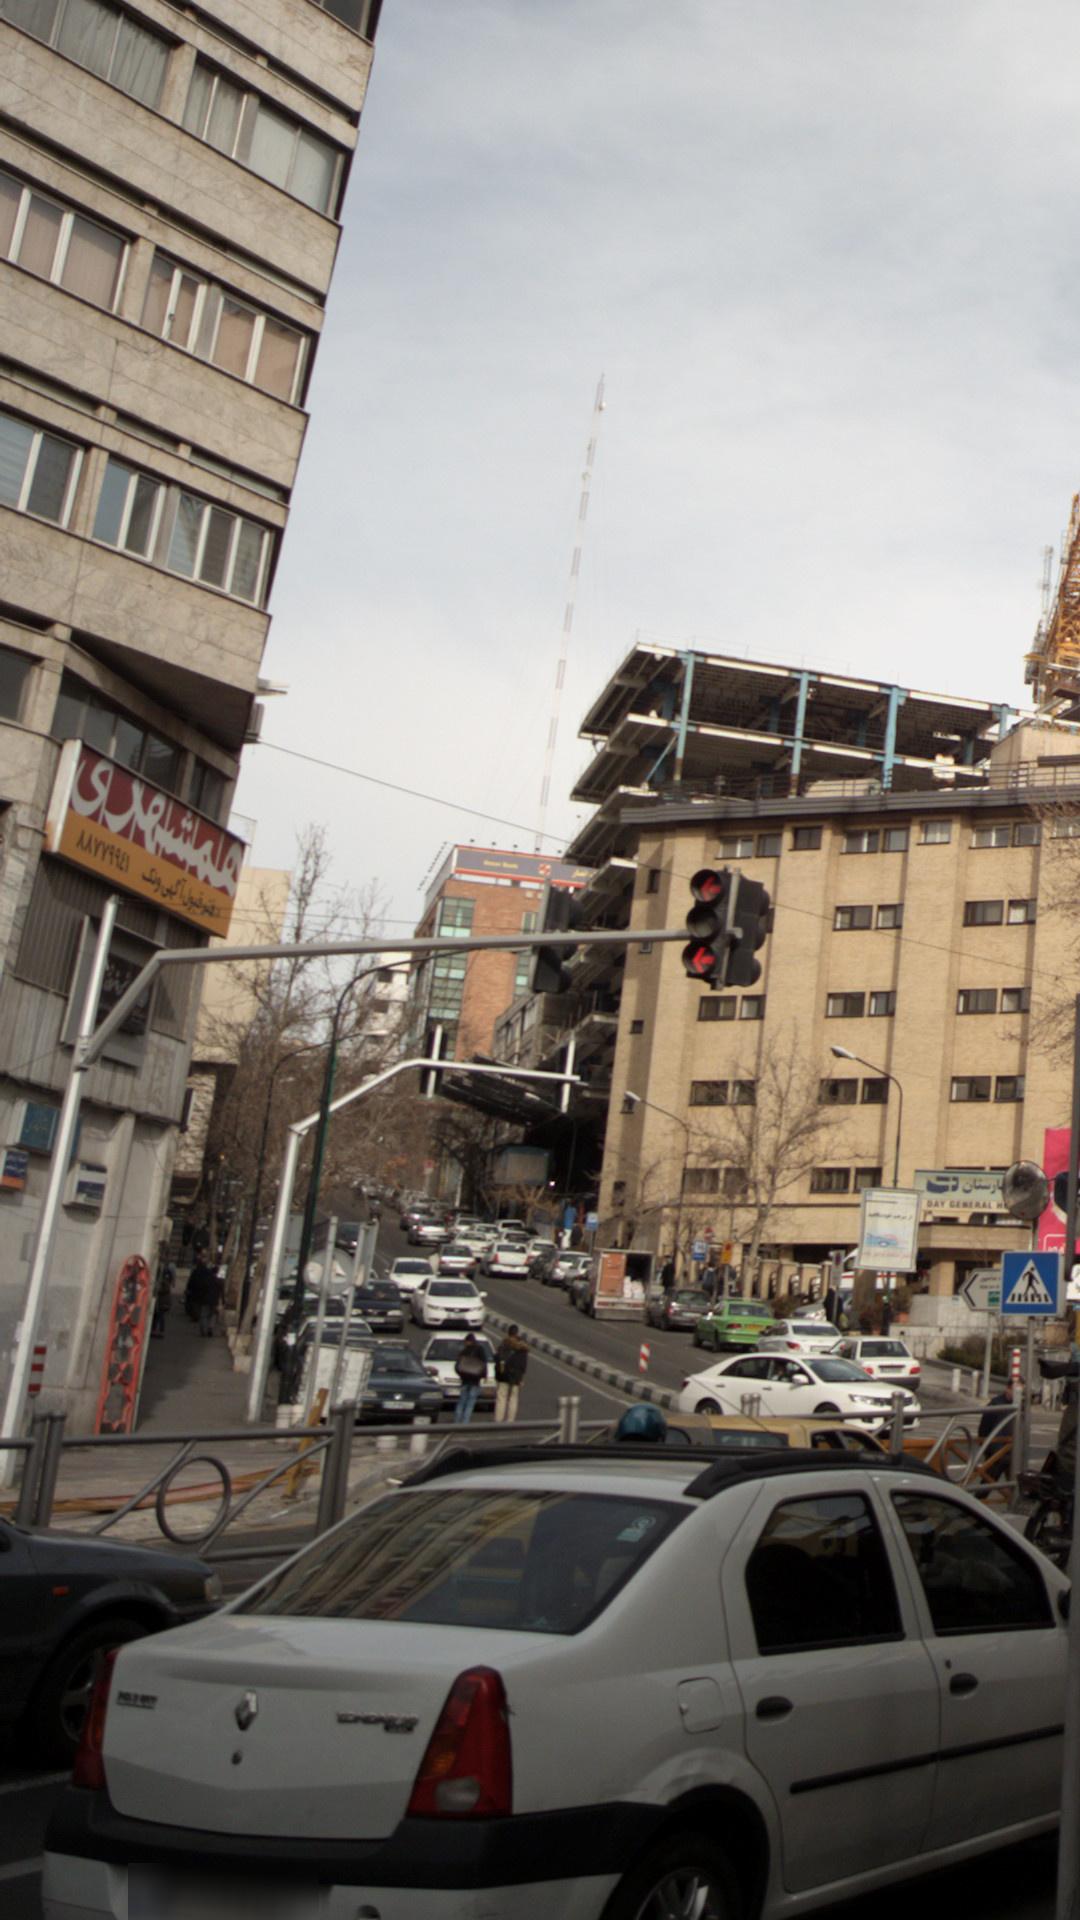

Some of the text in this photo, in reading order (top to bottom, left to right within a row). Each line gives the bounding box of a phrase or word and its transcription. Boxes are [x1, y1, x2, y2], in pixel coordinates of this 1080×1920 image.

[70, 760, 244, 897] همشهری
[141, 867, 162, 893] ونک
[161, 878, 187, 901] آگهی
[962, 1178, 1004, 1194] ارستان
[927, 1200, 945, 1208] DAY
[949, 1200, 992, 1209] GENERAL
